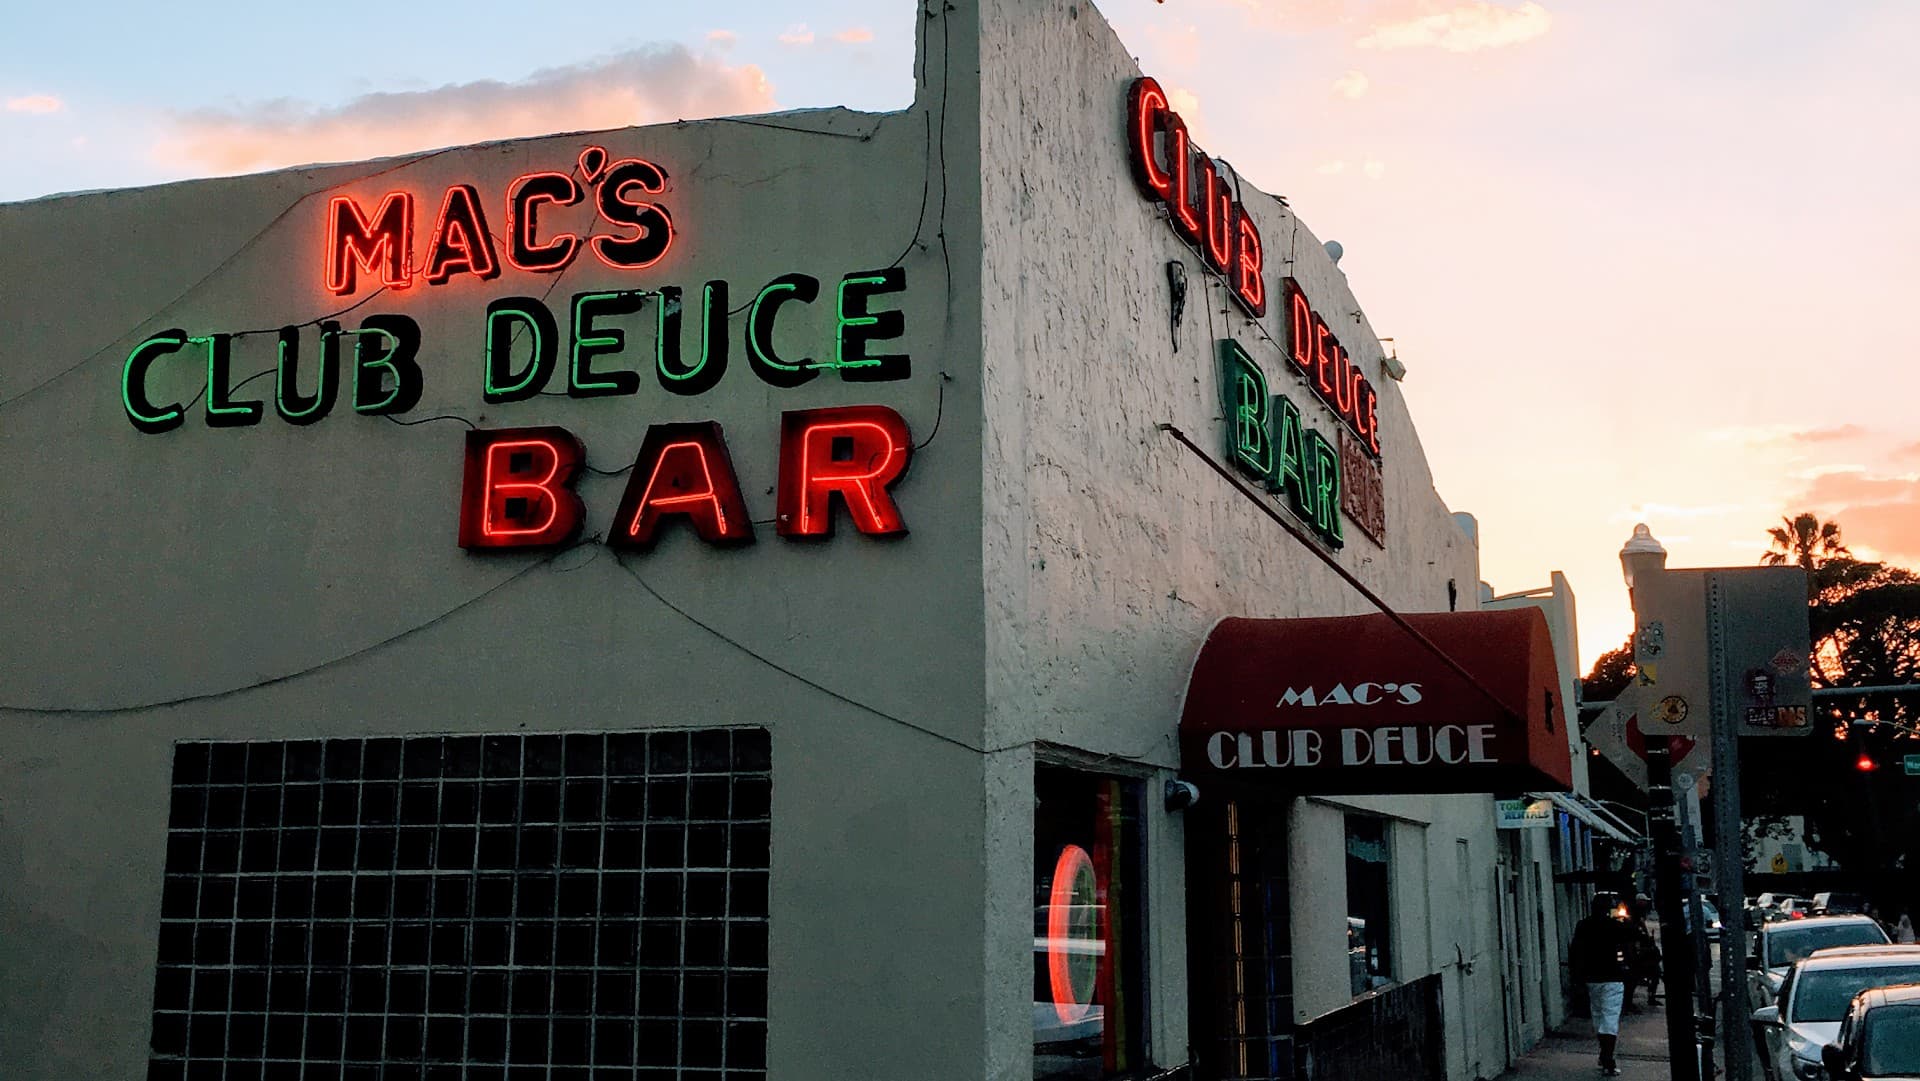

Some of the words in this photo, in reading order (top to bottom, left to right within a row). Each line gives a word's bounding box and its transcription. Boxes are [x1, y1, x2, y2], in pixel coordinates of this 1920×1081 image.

[325, 145, 675, 295] MAC'S
[1127, 76, 1266, 318] CLUB
[1283, 276, 1381, 459] DEUCE
[121, 313, 424, 434] CLUB
[482, 267, 912, 404] DEUCE
[458, 405, 914, 554] BAR
[1222, 339, 1344, 548] BAR
[1207, 729, 1323, 769] CLUB
[1341, 724, 1499, 766] DEUCE
[1276, 682, 1423, 708] MAC'S
